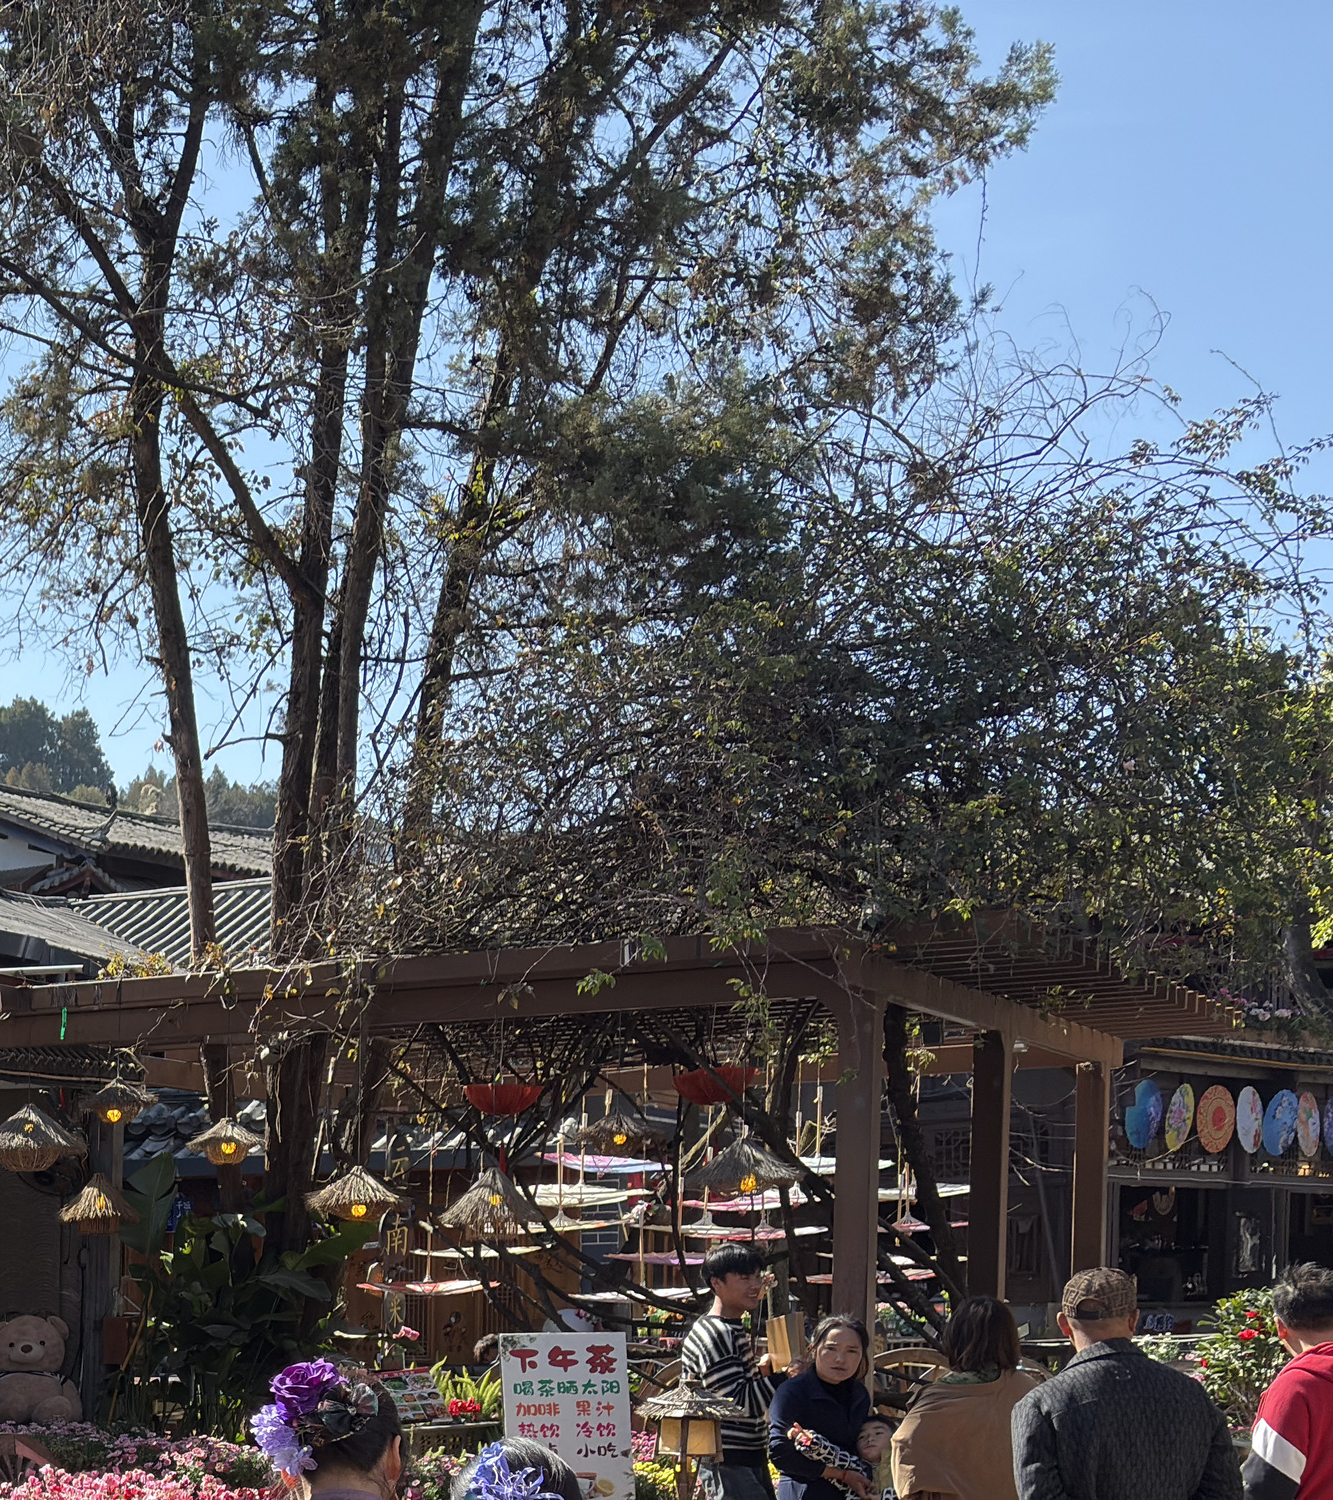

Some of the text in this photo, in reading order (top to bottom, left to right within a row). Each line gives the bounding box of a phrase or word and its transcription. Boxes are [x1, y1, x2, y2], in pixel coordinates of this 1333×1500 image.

[386, 1213, 409, 1256] 南
[509, 1343, 618, 1375] 下午茶
[513, 1378, 621, 1397] 喝茶晒太阳
[575, 1401, 615, 1417] 果汁
[575, 1421, 617, 1438] 冷饮
[576, 1442, 619, 1459] 小吃
